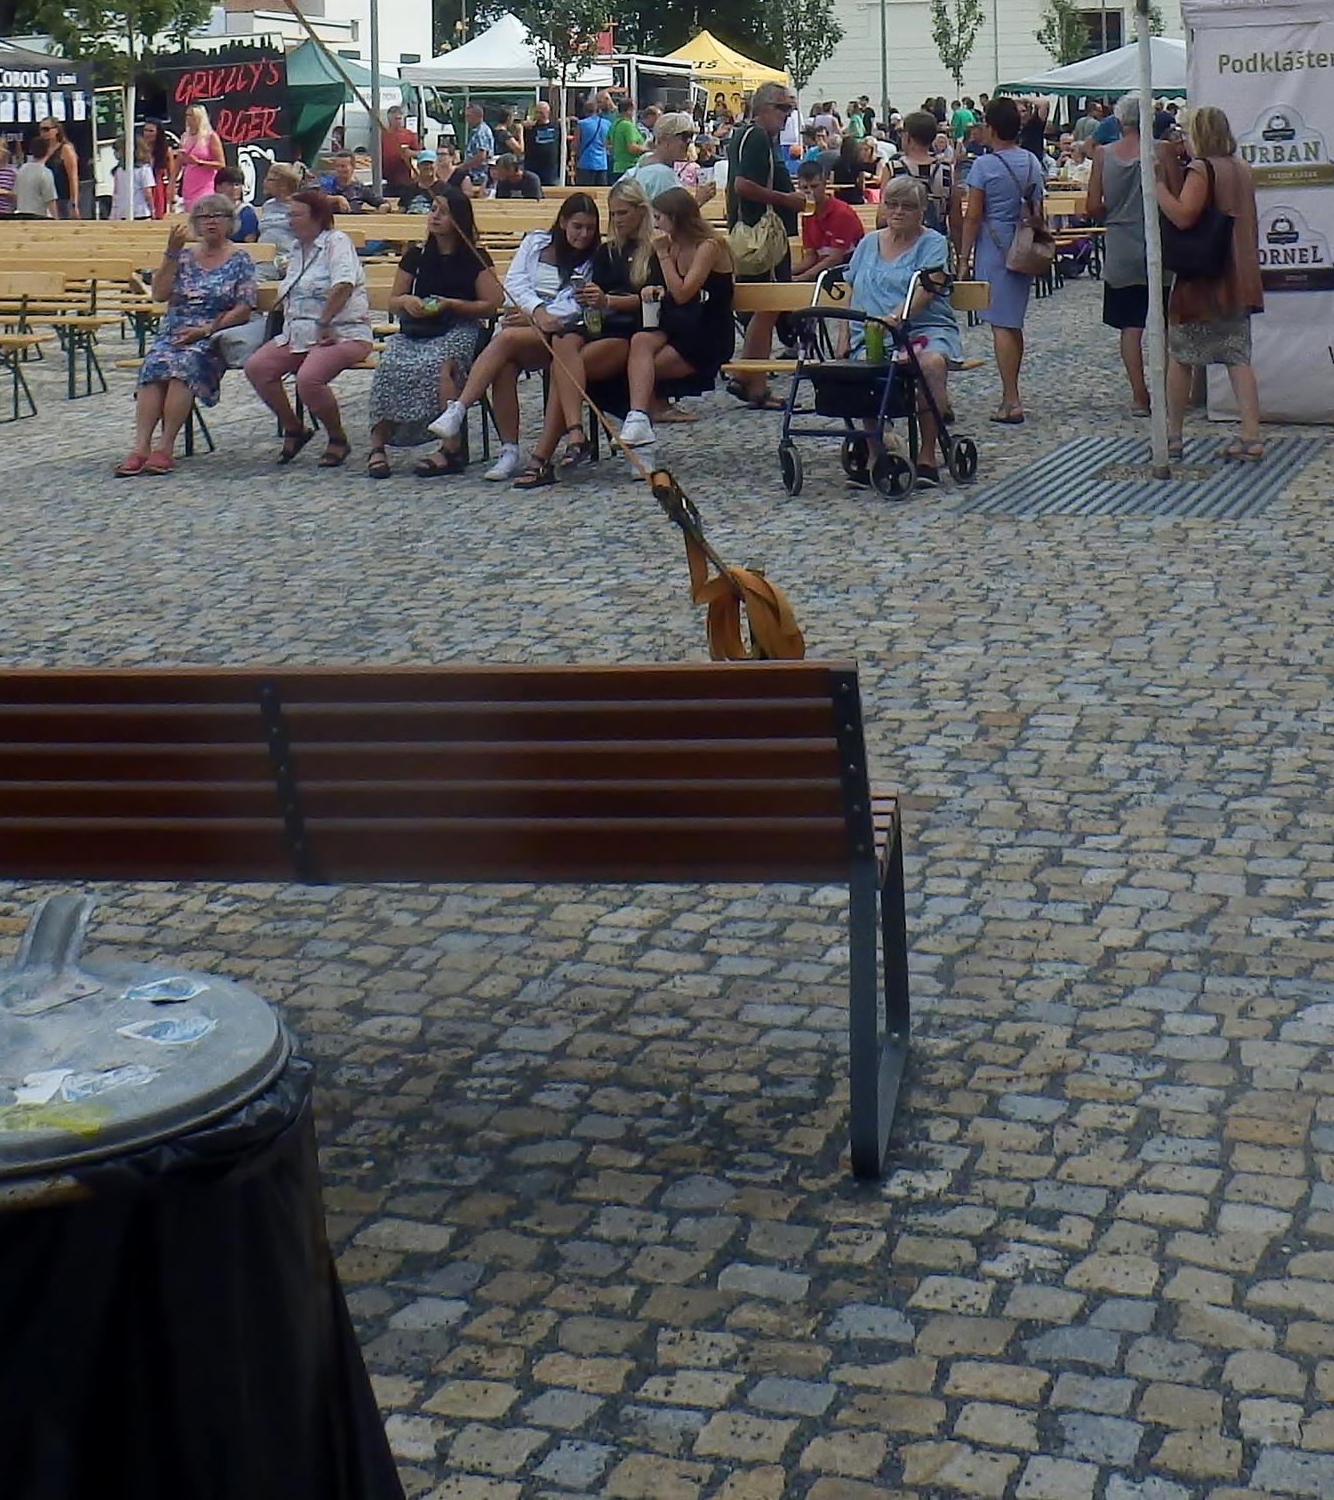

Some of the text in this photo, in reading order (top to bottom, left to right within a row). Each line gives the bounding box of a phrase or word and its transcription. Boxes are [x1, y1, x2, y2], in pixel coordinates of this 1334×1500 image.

[218, 106, 283, 143] RGER
[1240, 140, 1321, 164] URBAN
[1258, 245, 1324, 265] ORNEL
